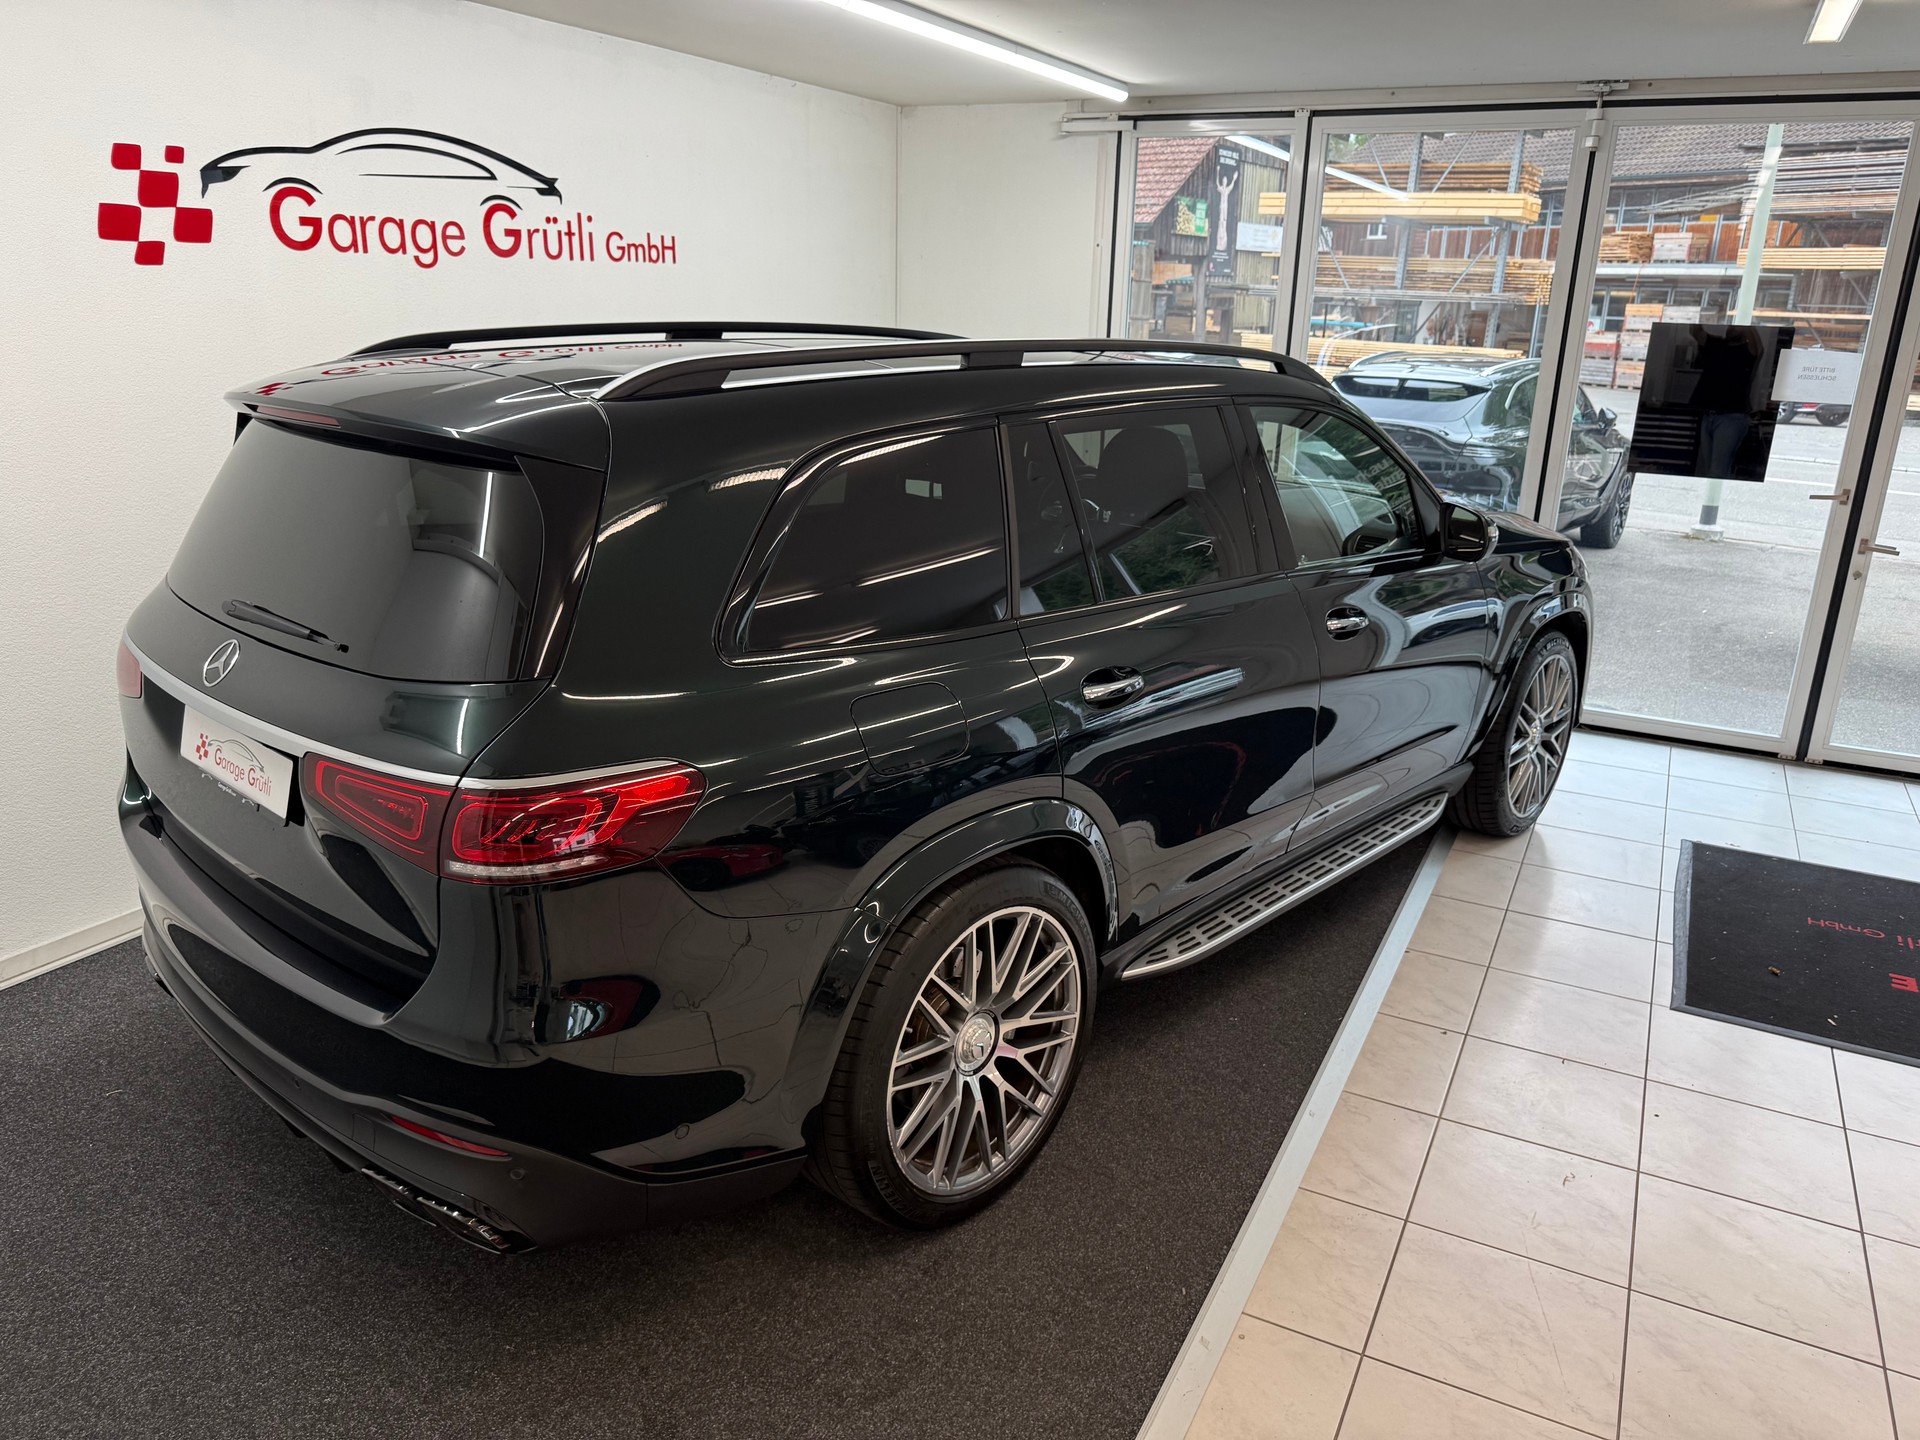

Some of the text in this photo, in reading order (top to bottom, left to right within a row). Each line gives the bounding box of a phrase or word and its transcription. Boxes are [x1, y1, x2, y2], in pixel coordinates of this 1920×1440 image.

[268, 185, 677, 270] Garage Grütli GmbH
[214, 748, 245, 781] Garage
[247, 767, 272, 797] Grütli
[1807, 917, 1885, 939] GmbH
